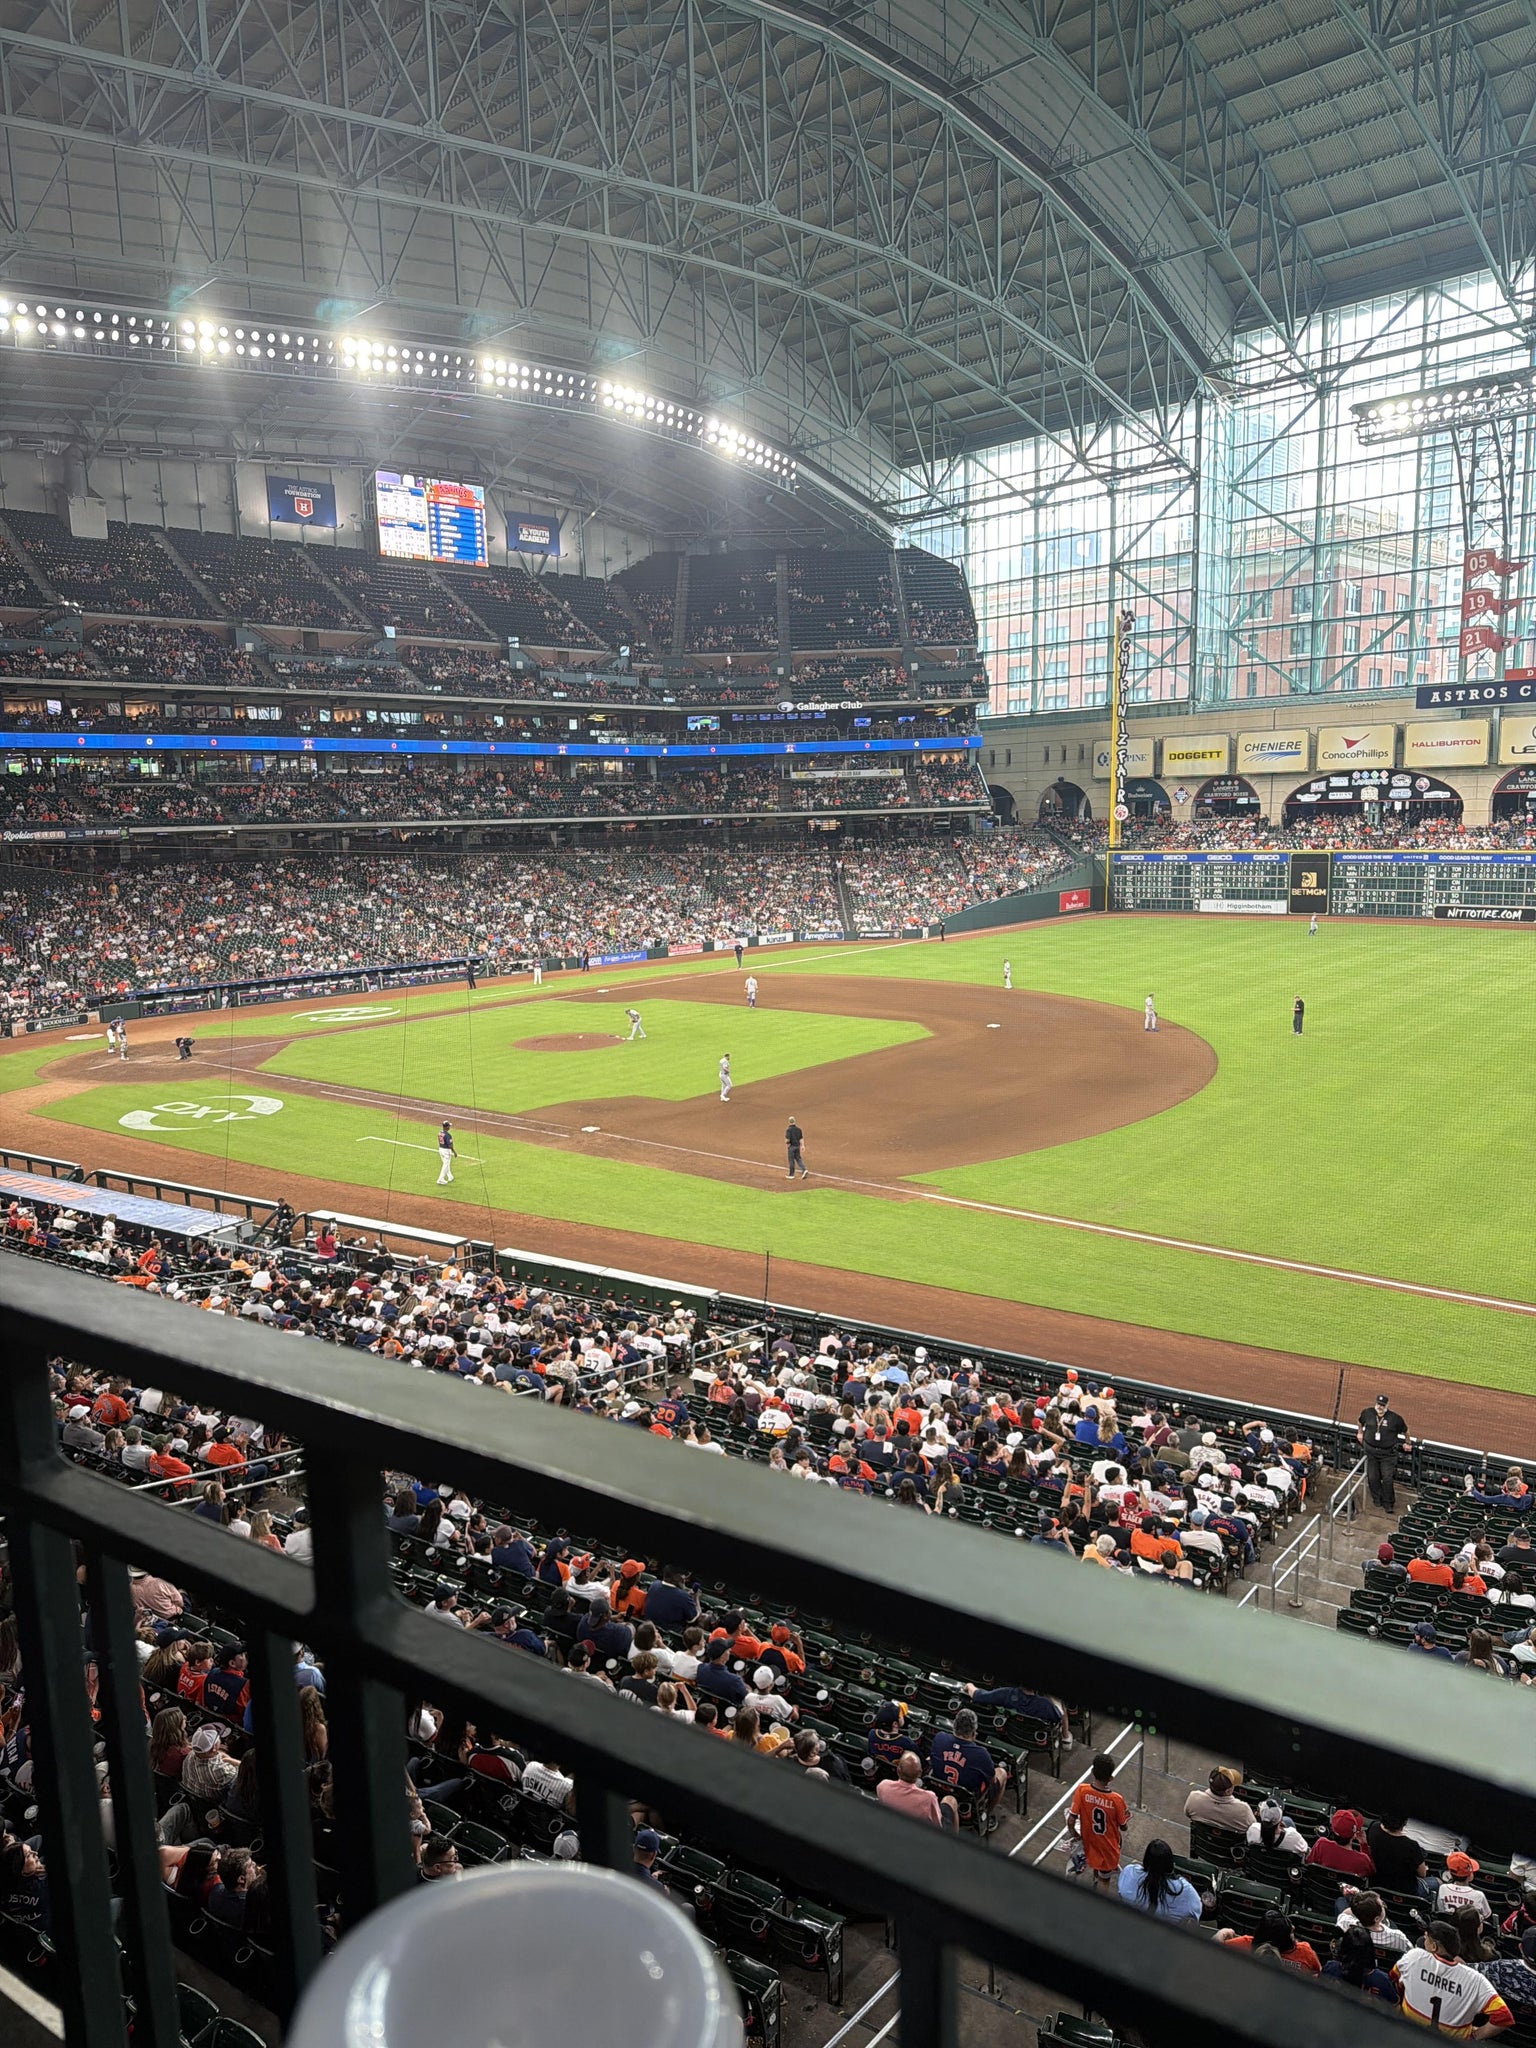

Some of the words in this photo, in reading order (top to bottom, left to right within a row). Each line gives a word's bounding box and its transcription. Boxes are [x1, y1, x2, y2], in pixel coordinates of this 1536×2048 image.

[284, 489, 321, 498] FOUNDATION
[300, 503, 308, 512] H
[519, 534, 550, 544] ACADEMY
[529, 528, 550, 538] YOUTH
[1470, 554, 1488, 572] 05
[1468, 594, 1486, 610] 19
[1466, 632, 1482, 646] 21
[1118, 638, 1130, 717] CHIKIN
[1430, 686, 1508, 703] ASTROS
[796, 702, 840, 711] Gallagher
[840, 701, 862, 709] Club
[1116, 720, 1130, 747] IZ
[1244, 740, 1302, 752] CHENIERE
[1412, 739, 1481, 748] HALLIBURTON
[1168, 750, 1222, 761] DOGGETT
[1322, 749, 1389, 760] ConocoPhillips
[1116, 750, 1128, 804] FAIR
[1447, 908, 1523, 921] NITTOTIRE.COM
[152, 1102, 256, 1122] OXY
[657, 1408, 675, 1422] 20
[943, 1751, 967, 1767] PEÑA
[944, 1765, 959, 1784] 3
[523, 1776, 552, 1799] OSWALT
[1092, 1806, 1106, 1835] 9
[1420, 1969, 1463, 1997] CORREA
[1430, 1996, 1442, 2029] 1
